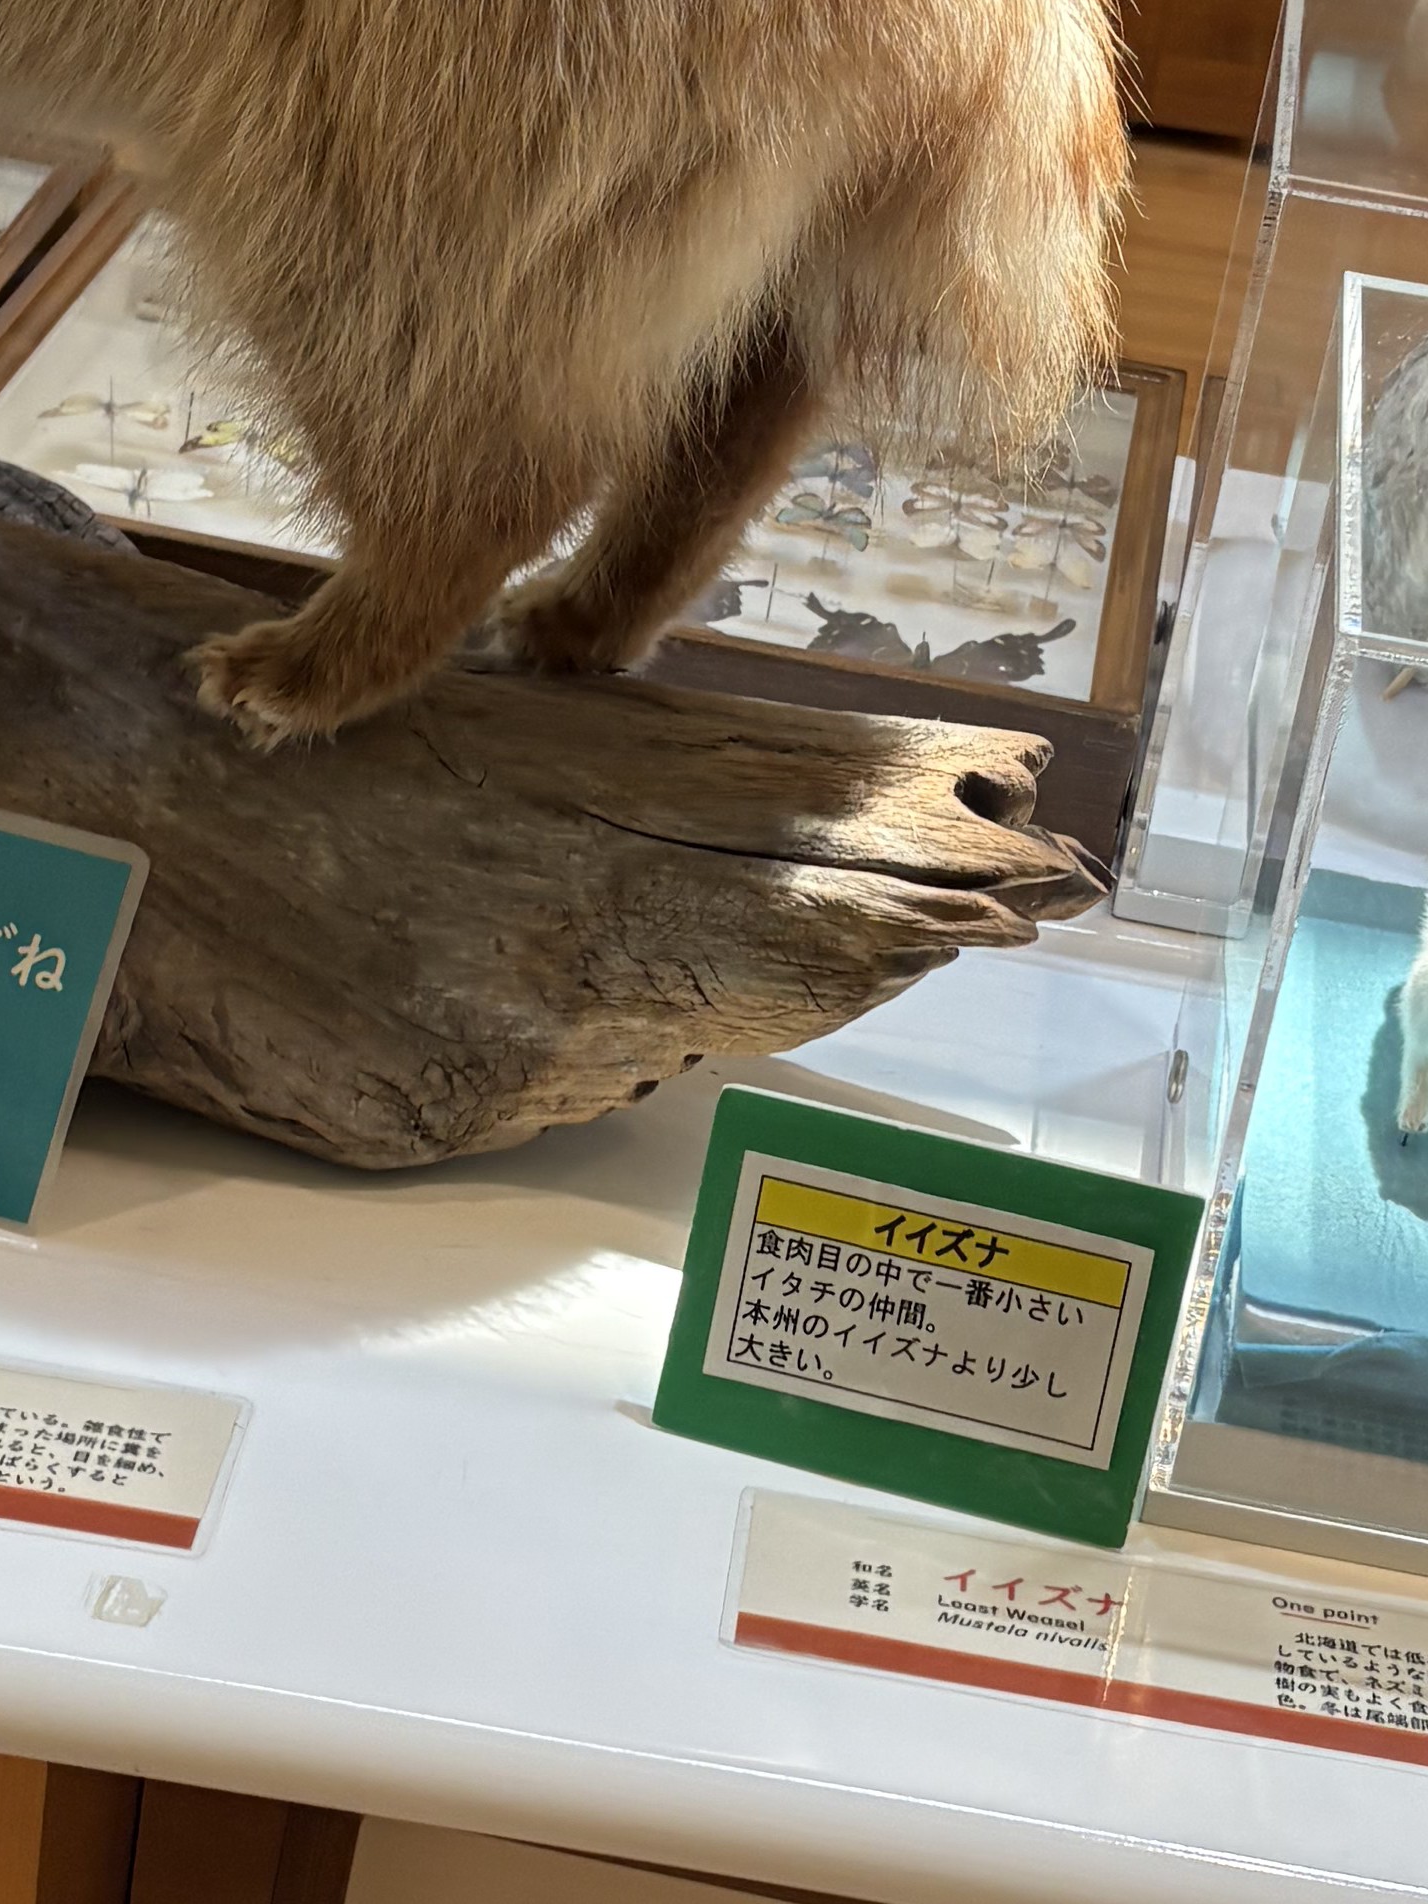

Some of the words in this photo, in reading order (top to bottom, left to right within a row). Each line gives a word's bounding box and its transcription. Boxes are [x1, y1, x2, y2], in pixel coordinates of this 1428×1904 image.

[873, 1212, 1011, 1270] イイズナ
[749, 1268, 939, 1334] イタチの仲間。
[756, 1229, 1086, 1329] 食肉目の中で一番小さい
[734, 1336, 835, 1381] 大きい。
[743, 1299, 1069, 1400] 本州のイイズナより少し
[851, 1578, 891, 1596] 英名
[938, 1594, 999, 1618] Least
[1006, 1603, 1085, 1633] Weasel
[852, 1560, 893, 1578] 和名
[943, 1569, 1127, 1618] イイズナ
[1271, 1596, 1316, 1616] One
[1323, 1604, 1380, 1626] point
[848, 1595, 890, 1612] 学名
[937, 1612, 1030, 1638] Mustela
[1035, 1629, 1112, 1653] nivalis
